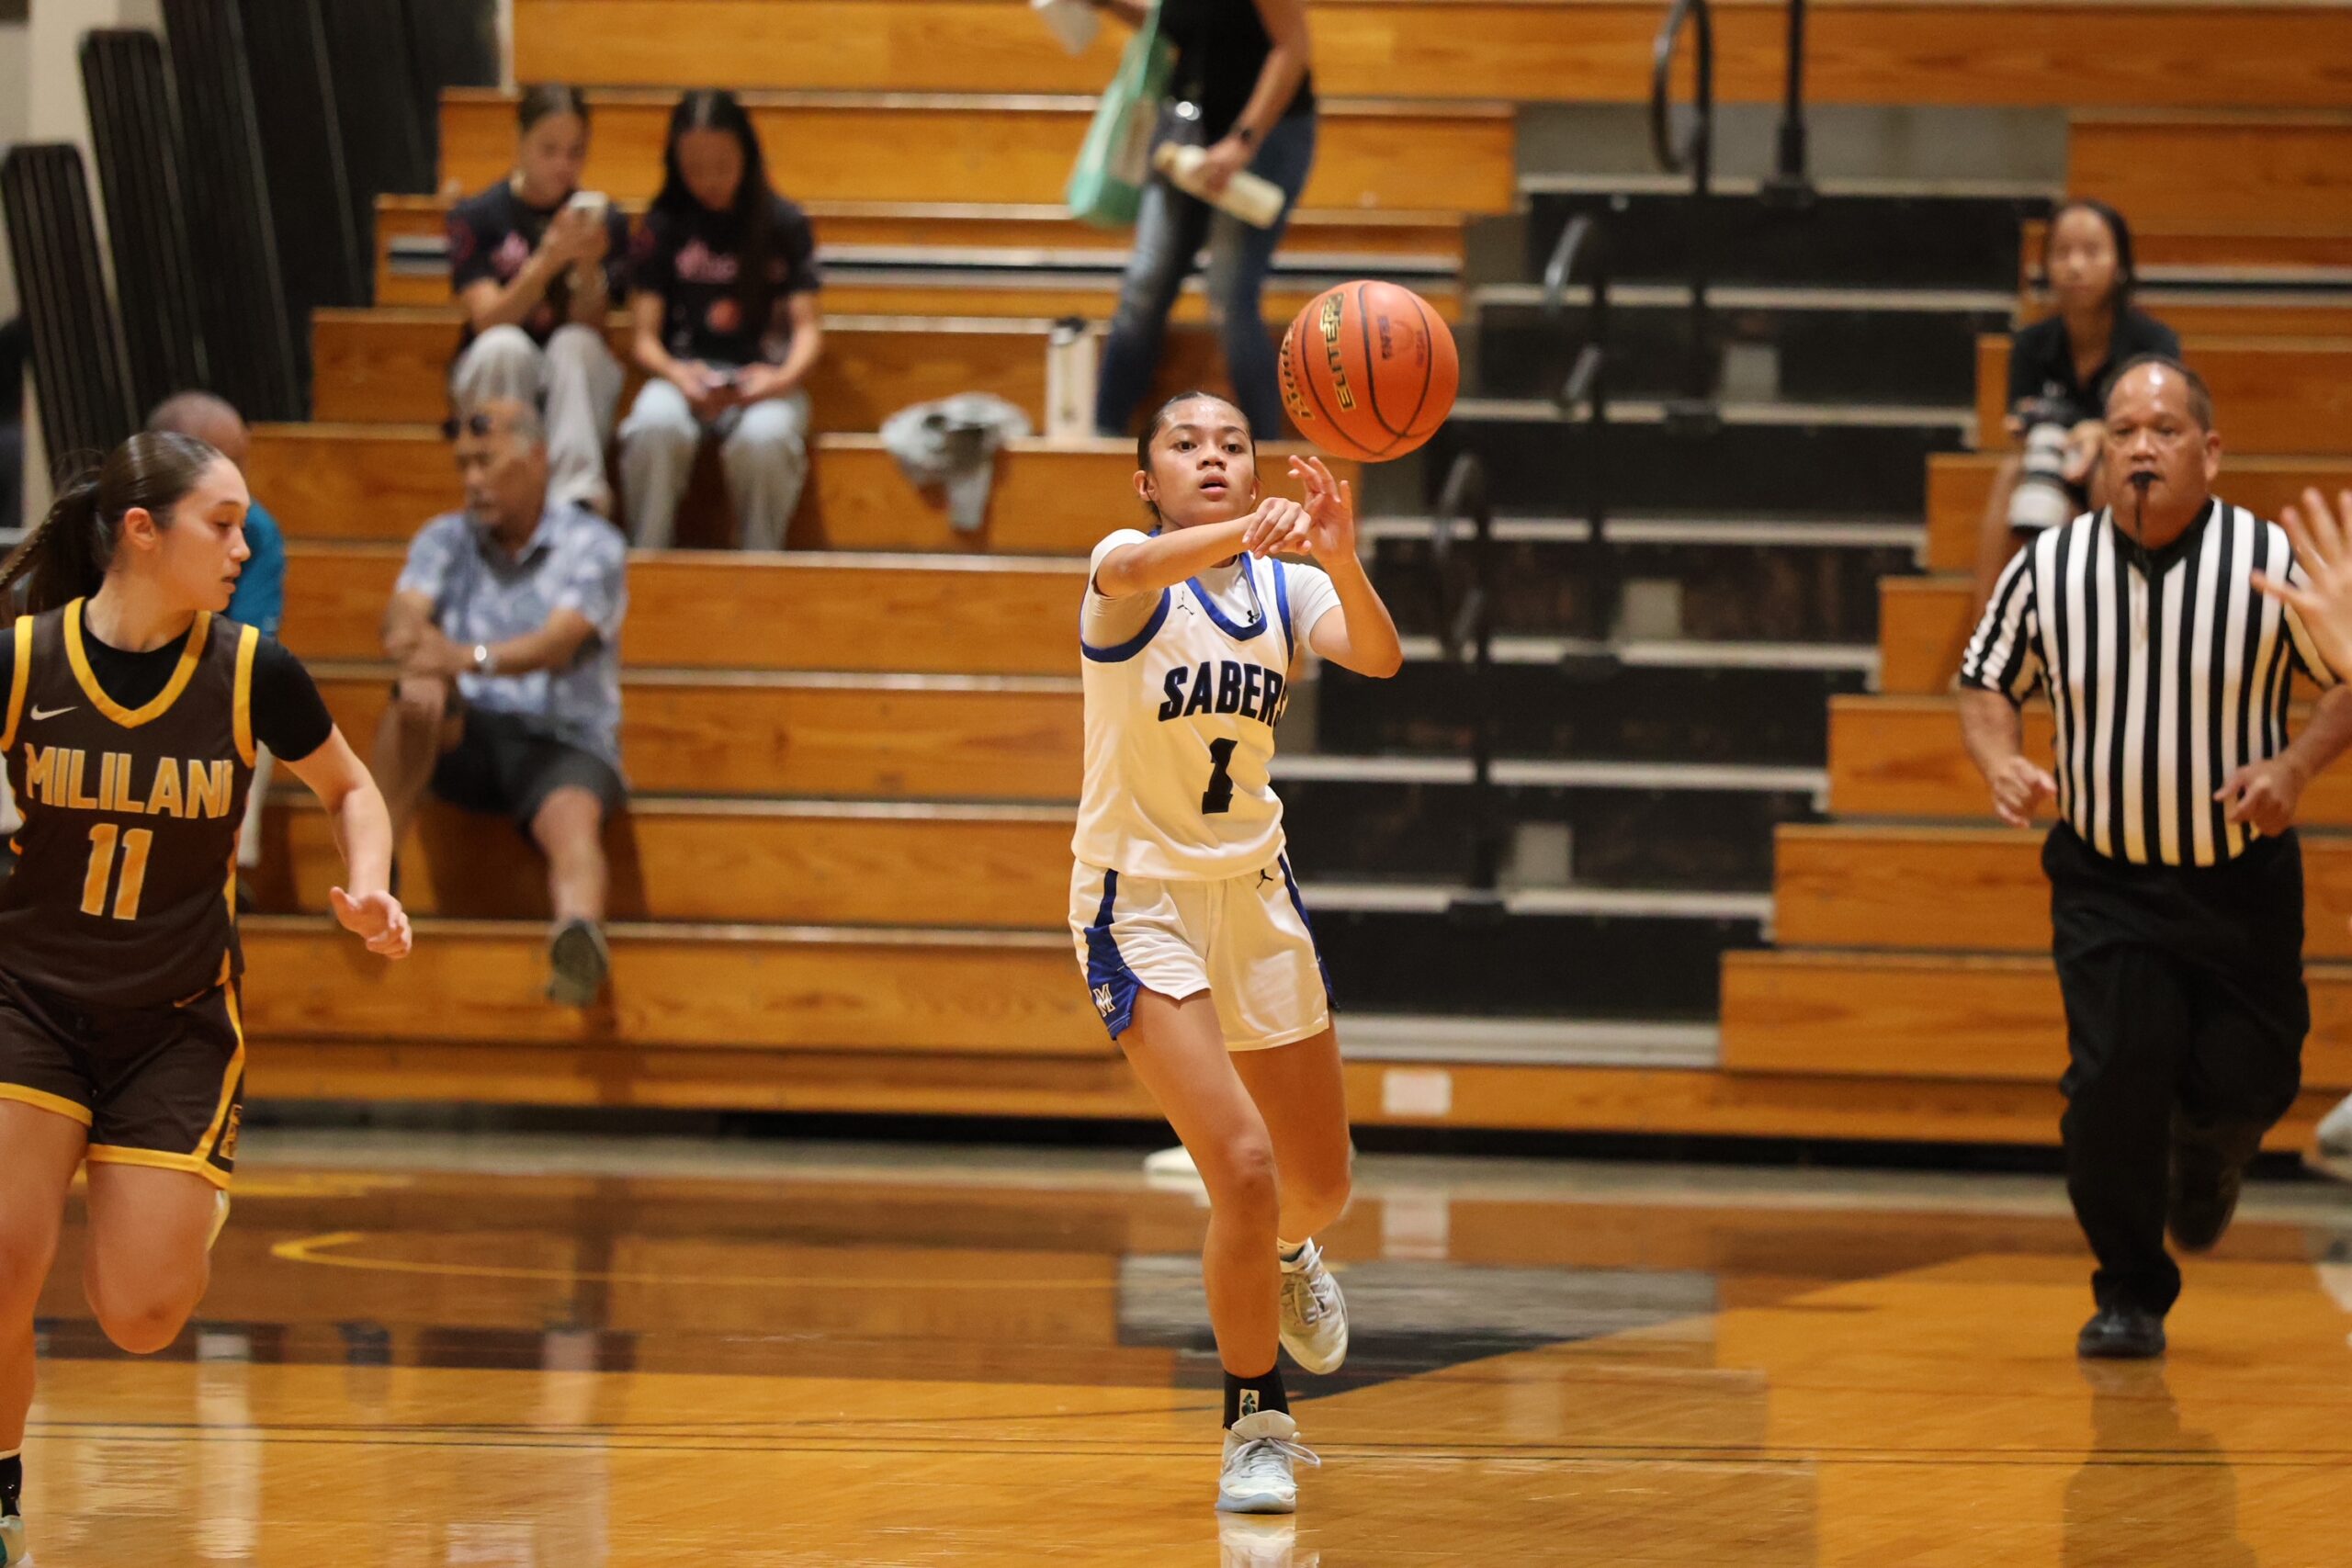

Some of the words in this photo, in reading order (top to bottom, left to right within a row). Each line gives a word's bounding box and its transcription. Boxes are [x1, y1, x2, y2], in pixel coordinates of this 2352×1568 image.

[24, 741, 234, 819] MILILANI
[1202, 738, 1238, 815] 1
[80, 822, 153, 921] 11
